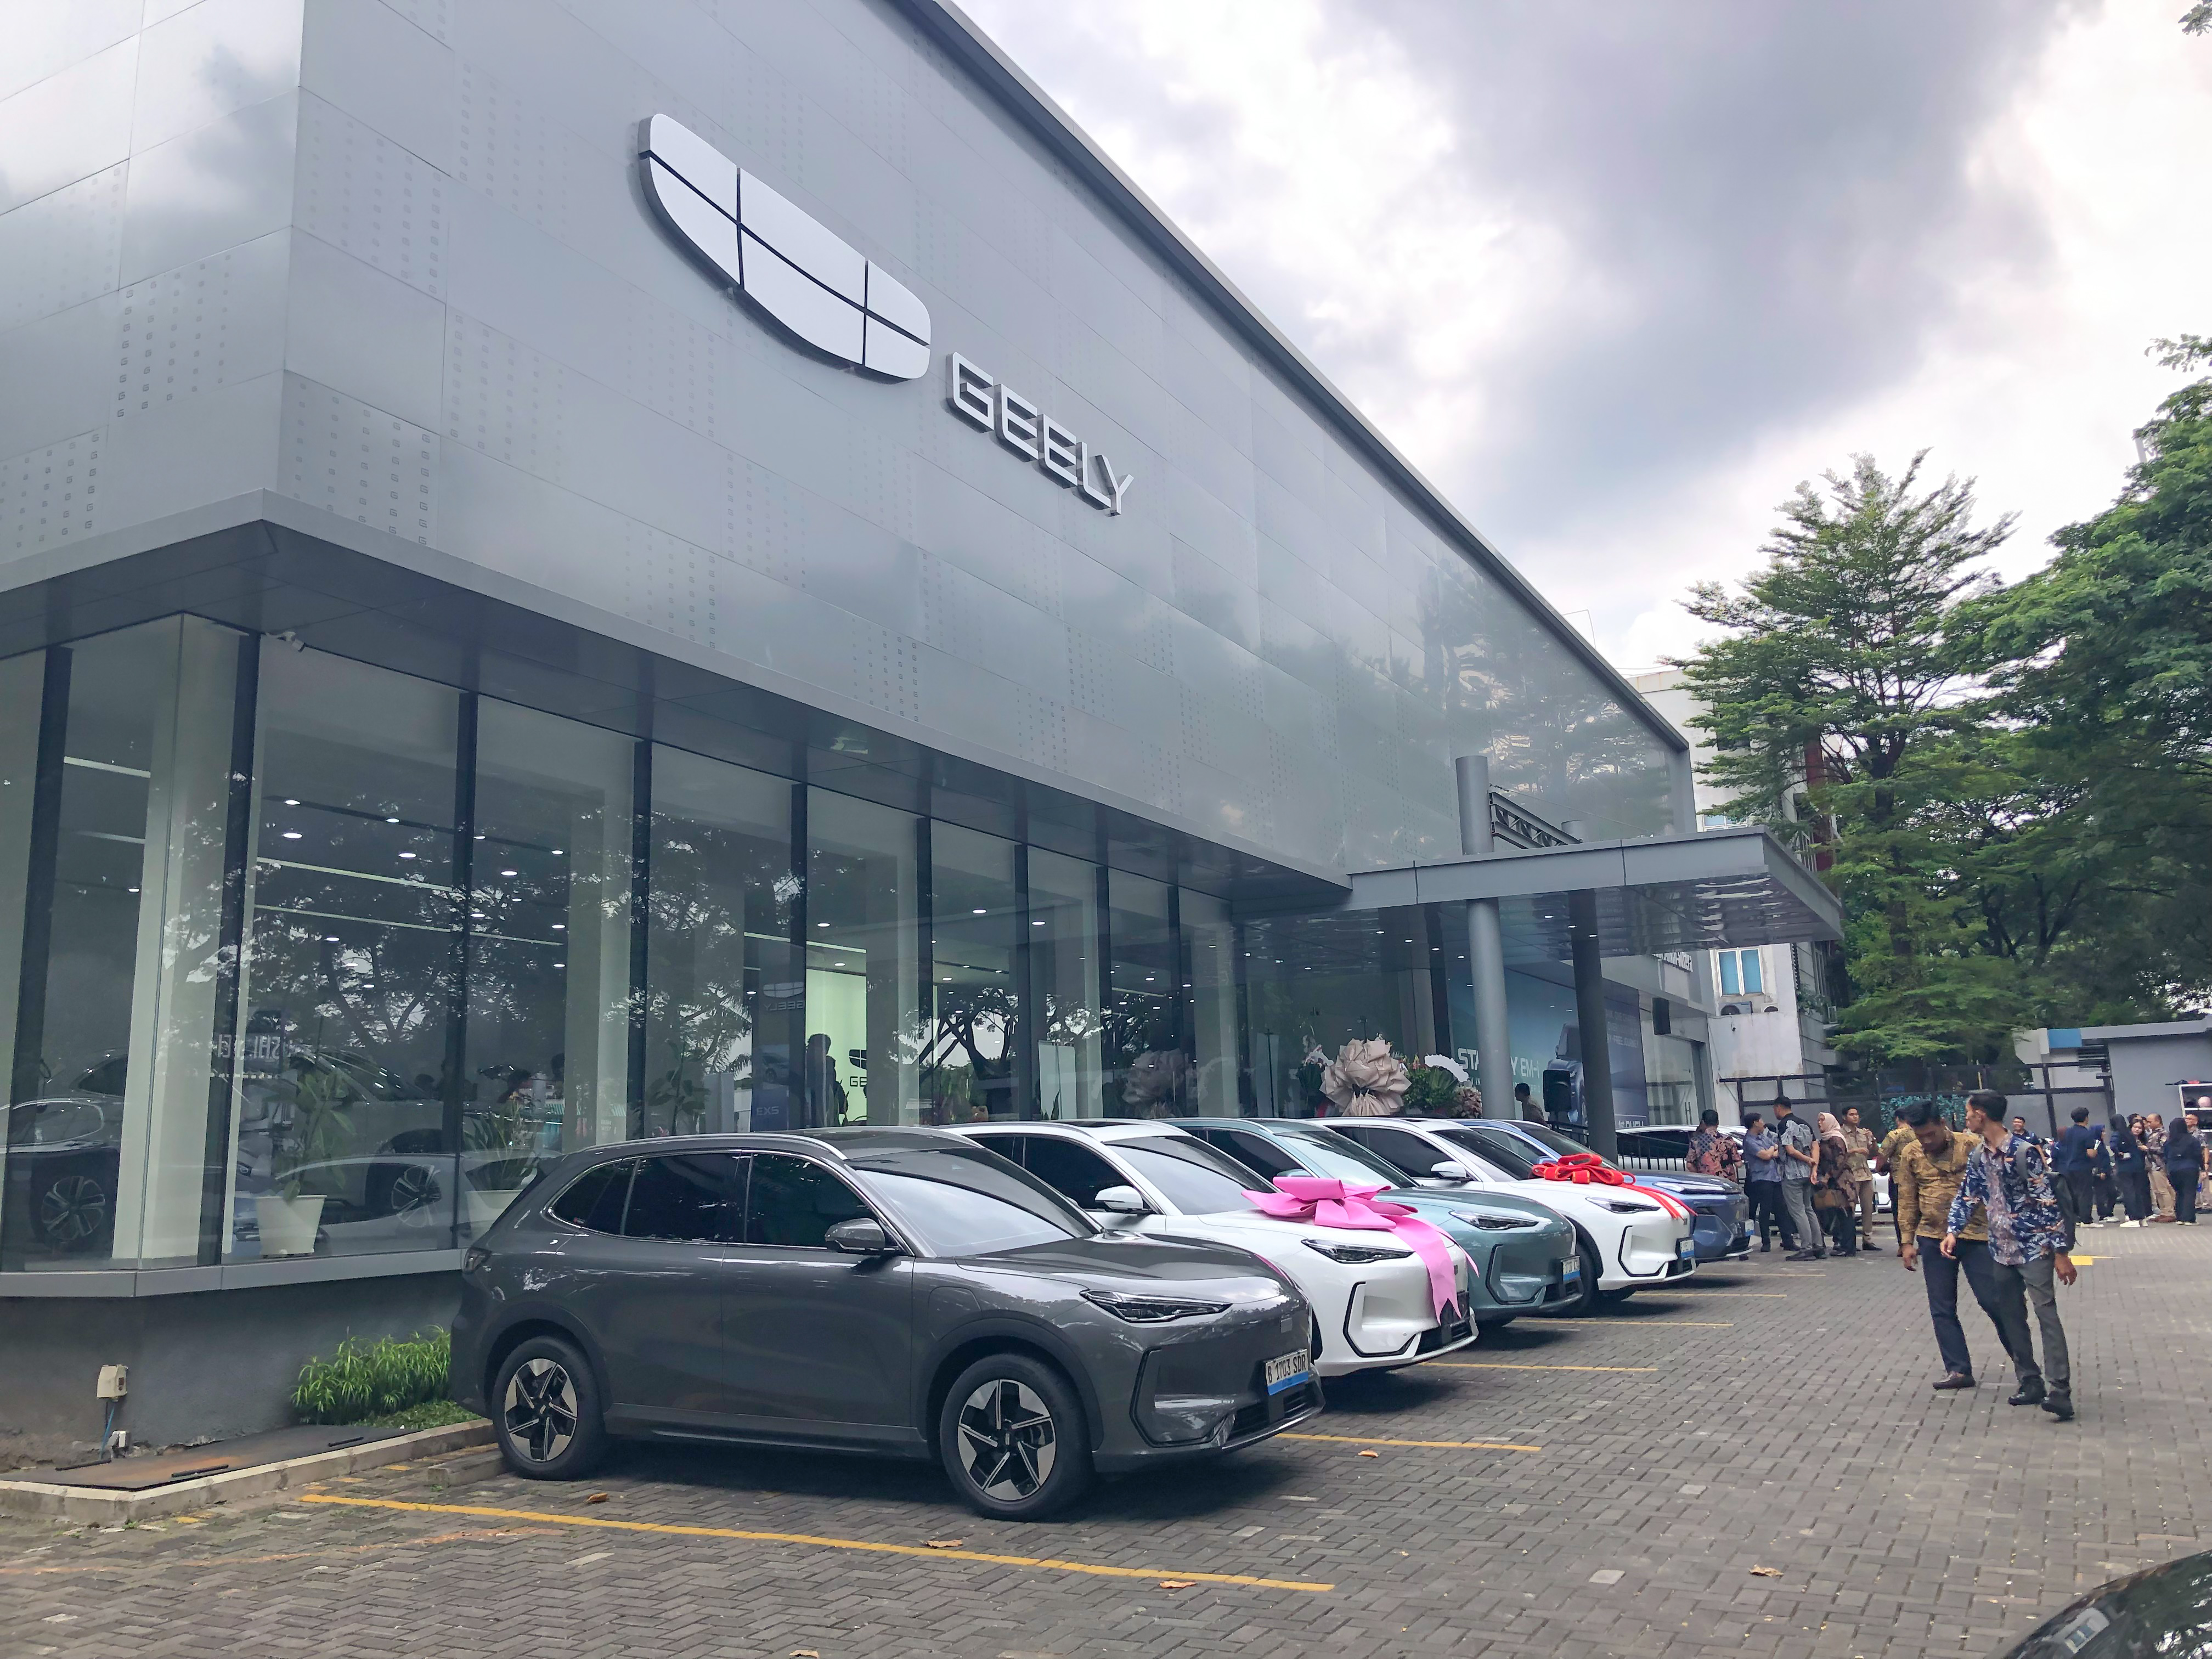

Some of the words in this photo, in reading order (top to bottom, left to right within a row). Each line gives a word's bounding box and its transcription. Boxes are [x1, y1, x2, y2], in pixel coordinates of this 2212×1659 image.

[946, 352, 1134, 517] GEELY
[1268, 1365, 1272, 1383] B
[1293, 1354, 1306, 1373] SDR
